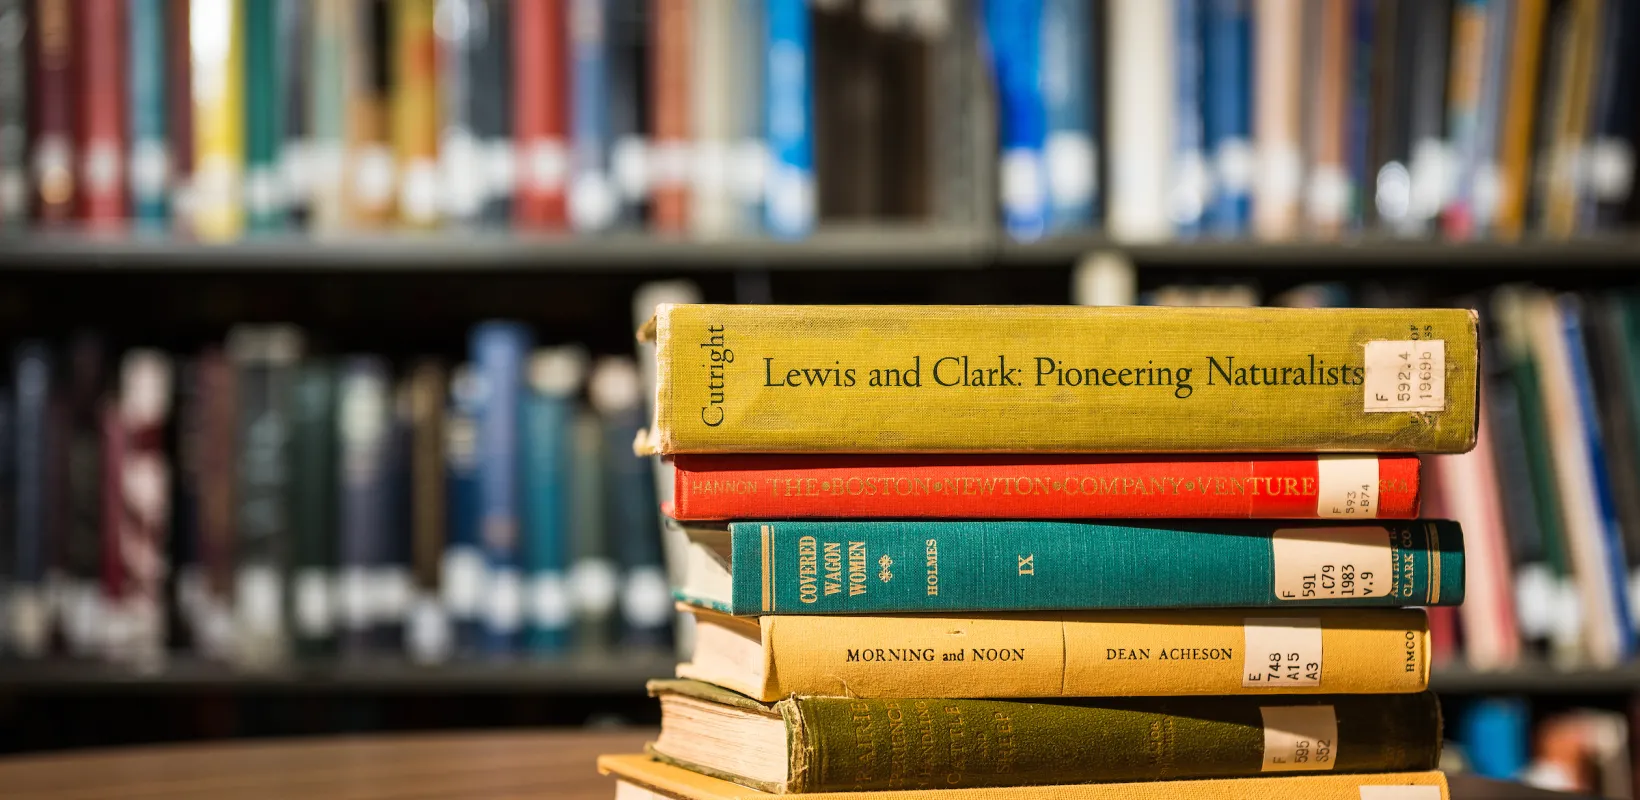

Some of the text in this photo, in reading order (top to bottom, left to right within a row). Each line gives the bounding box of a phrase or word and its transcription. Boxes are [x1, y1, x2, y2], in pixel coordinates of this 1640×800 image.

[700, 323, 734, 428] Cutright
[763, 354, 1365, 399] Lewis and Clark: Pioneering Naturalists
[1397, 350, 1412, 402] 592.4
[1419, 351, 1433, 401] 1969b
[1375, 392, 1389, 403] F
[692, 479, 757, 496] HANNON
[1332, 506, 1342, 515] F
[1345, 490, 1358, 515] 593
[799, 535, 817, 604] COVERED
[823, 541, 842, 597] WAGON
[848, 540, 866, 597] WOMEN
[926, 538, 938, 597] HOLMES
[1018, 553, 1035, 576] IX
[1403, 553, 1414, 597] CLARK
[1303, 573, 1316, 597] 591
[1321, 564, 1335, 595] .C79
[1341, 563, 1355, 596] 1983
[1360, 571, 1374, 596] v.9
[1283, 590, 1296, 599] F
[846, 647, 1026, 662] MORNING and NOON
[1106, 647, 1233, 661] DEAN ACHESON
[1405, 630, 1417, 673] HMCO
[1248, 672, 1262, 682] E
[1266, 651, 1282, 683] 748
[1286, 651, 1300, 681] A15
[1305, 662, 1319, 681] A3
[1273, 756, 1287, 764] F
[1294, 740, 1310, 764] 595
[1315, 739, 1331, 763] S52
